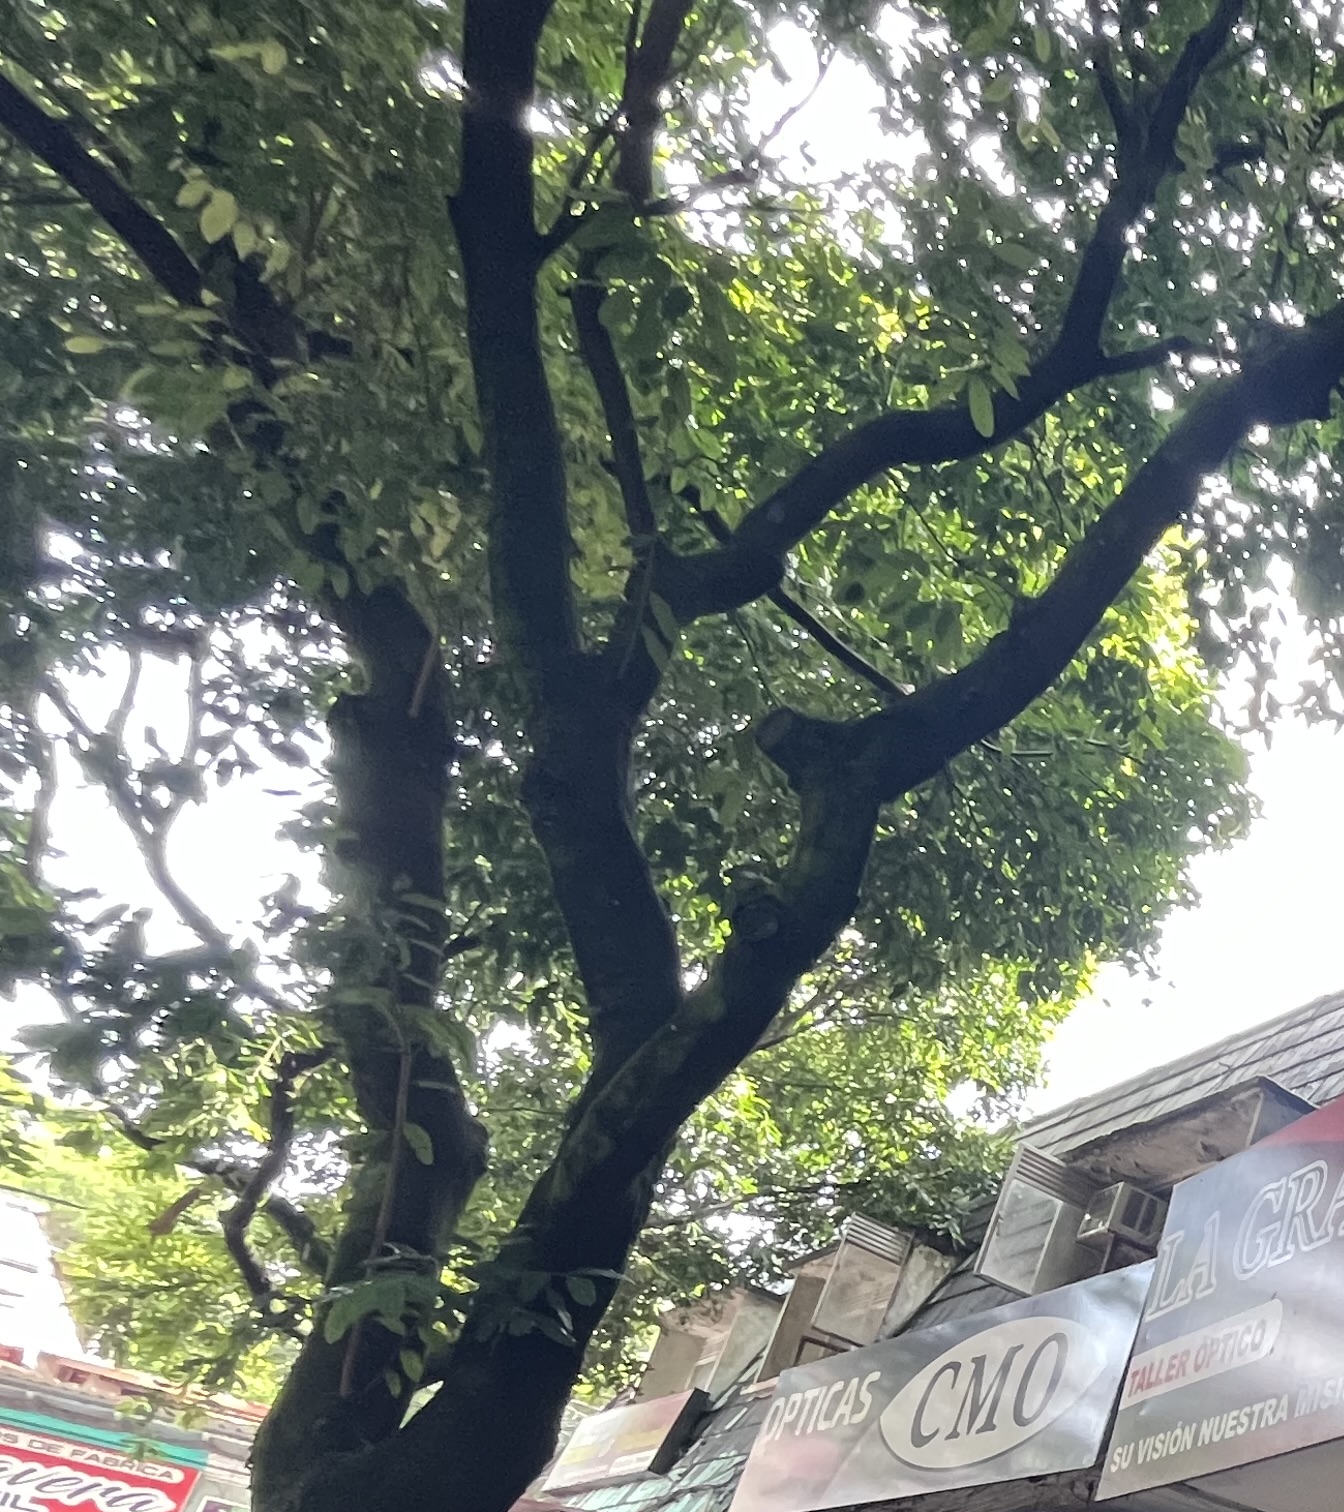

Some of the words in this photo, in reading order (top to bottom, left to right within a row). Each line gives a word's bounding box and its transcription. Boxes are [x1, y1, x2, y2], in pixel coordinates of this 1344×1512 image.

[1145, 1210, 1218, 1322] LA
[761, 1370, 882, 1442] OPTICAS
[910, 1332, 1069, 1448] CMO
[1127, 1349, 1190, 1398] TALLER
[28, 1438, 62, 1454] DE
[1109, 1442, 1134, 1473] SU
[1135, 1421, 1197, 1465] VISIÓN
[1197, 1394, 1289, 1447] NUESTRA
